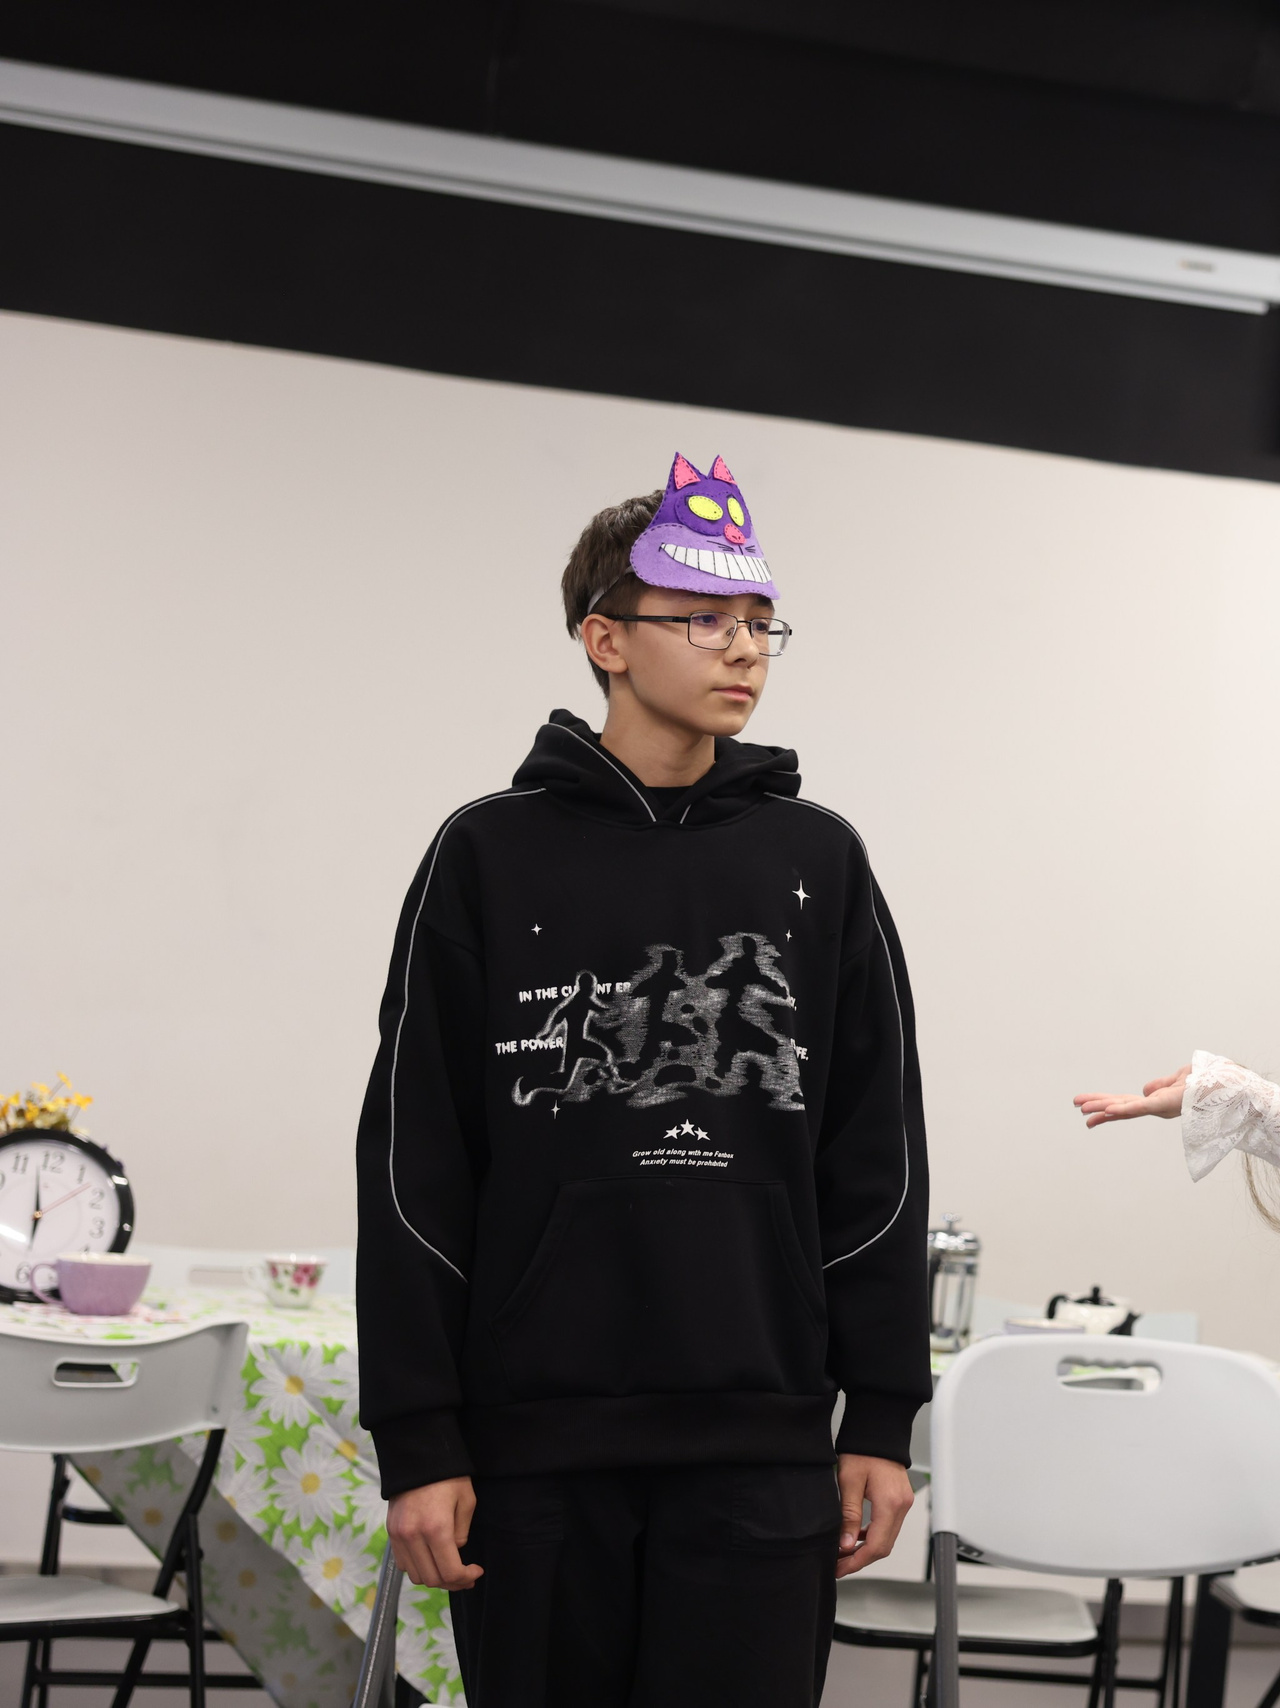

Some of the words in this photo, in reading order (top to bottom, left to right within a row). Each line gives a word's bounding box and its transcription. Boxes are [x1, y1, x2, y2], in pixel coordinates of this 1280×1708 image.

[519, 990, 532, 1003] IN
[535, 987, 558, 1000] THE
[495, 1040, 518, 1055] THE
[521, 1036, 564, 1052] POWER
[12, 1152, 30, 1174] 11
[42, 1151, 65, 1173] 12
[640, 1158, 668, 1166] Anxiety
[696, 1159, 729, 1167] prohibited
[666, 1148, 687, 1157] along
[77, 1163, 86, 1185] 1
[89, 1187, 105, 1210] 2
[89, 1216, 106, 1239] 3
[15, 1261, 31, 1284] 6
